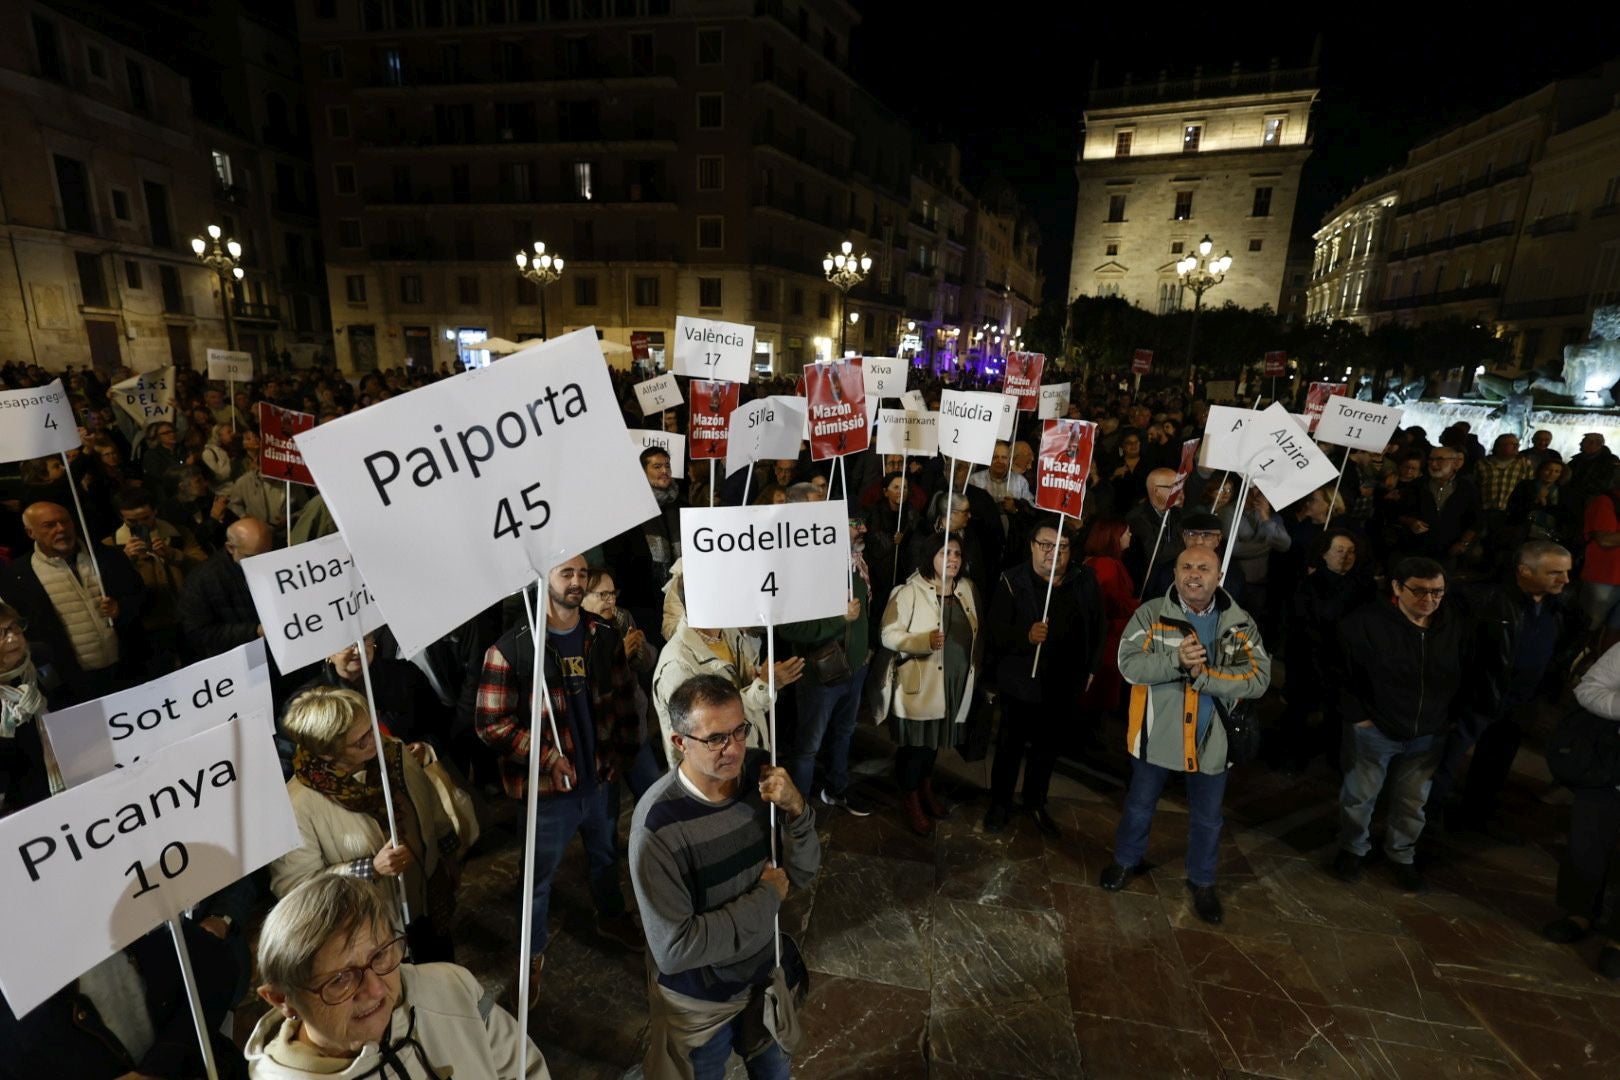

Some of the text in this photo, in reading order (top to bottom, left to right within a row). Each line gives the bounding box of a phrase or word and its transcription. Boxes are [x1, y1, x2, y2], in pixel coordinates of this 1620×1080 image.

[684, 326, 745, 349] València
[704, 352, 721, 367] 17
[871, 364, 892, 375] Xiva
[642, 381, 668, 395] Alfafar
[877, 380, 884, 390] 8
[1007, 375, 1030, 386] Mazón
[126, 393, 158, 405] DEL
[654, 395, 665, 405] 15
[748, 407, 775, 428] Silla
[813, 400, 852, 420] Mazón
[942, 400, 993, 422] L'Alcúdia
[1338, 404, 1389, 425] Torrent
[44, 412, 58, 430] 4
[693, 413, 725, 426] Mazón
[815, 413, 865, 436] dimissió
[883, 415, 936, 426] Vilamarxant
[693, 427, 728, 440] dimissi
[904, 430, 911, 441] 1
[952, 428, 960, 443] 2
[1345, 426, 1363, 439] 11
[363, 382, 588, 507] Paiporta
[642, 436, 669, 449] Utiel
[1270, 428, 1310, 470] Alzira
[1043, 456, 1081, 475] Mazón
[1259, 457, 1275, 472] 1
[492, 481, 553, 541] 45
[693, 522, 837, 554] Godelleta
[760, 571, 779, 598] 4
[284, 583, 375, 640] de Túri
[108, 678, 236, 741] Sot de
[18, 759, 238, 882] Picanya
[124, 841, 189, 899] 10
